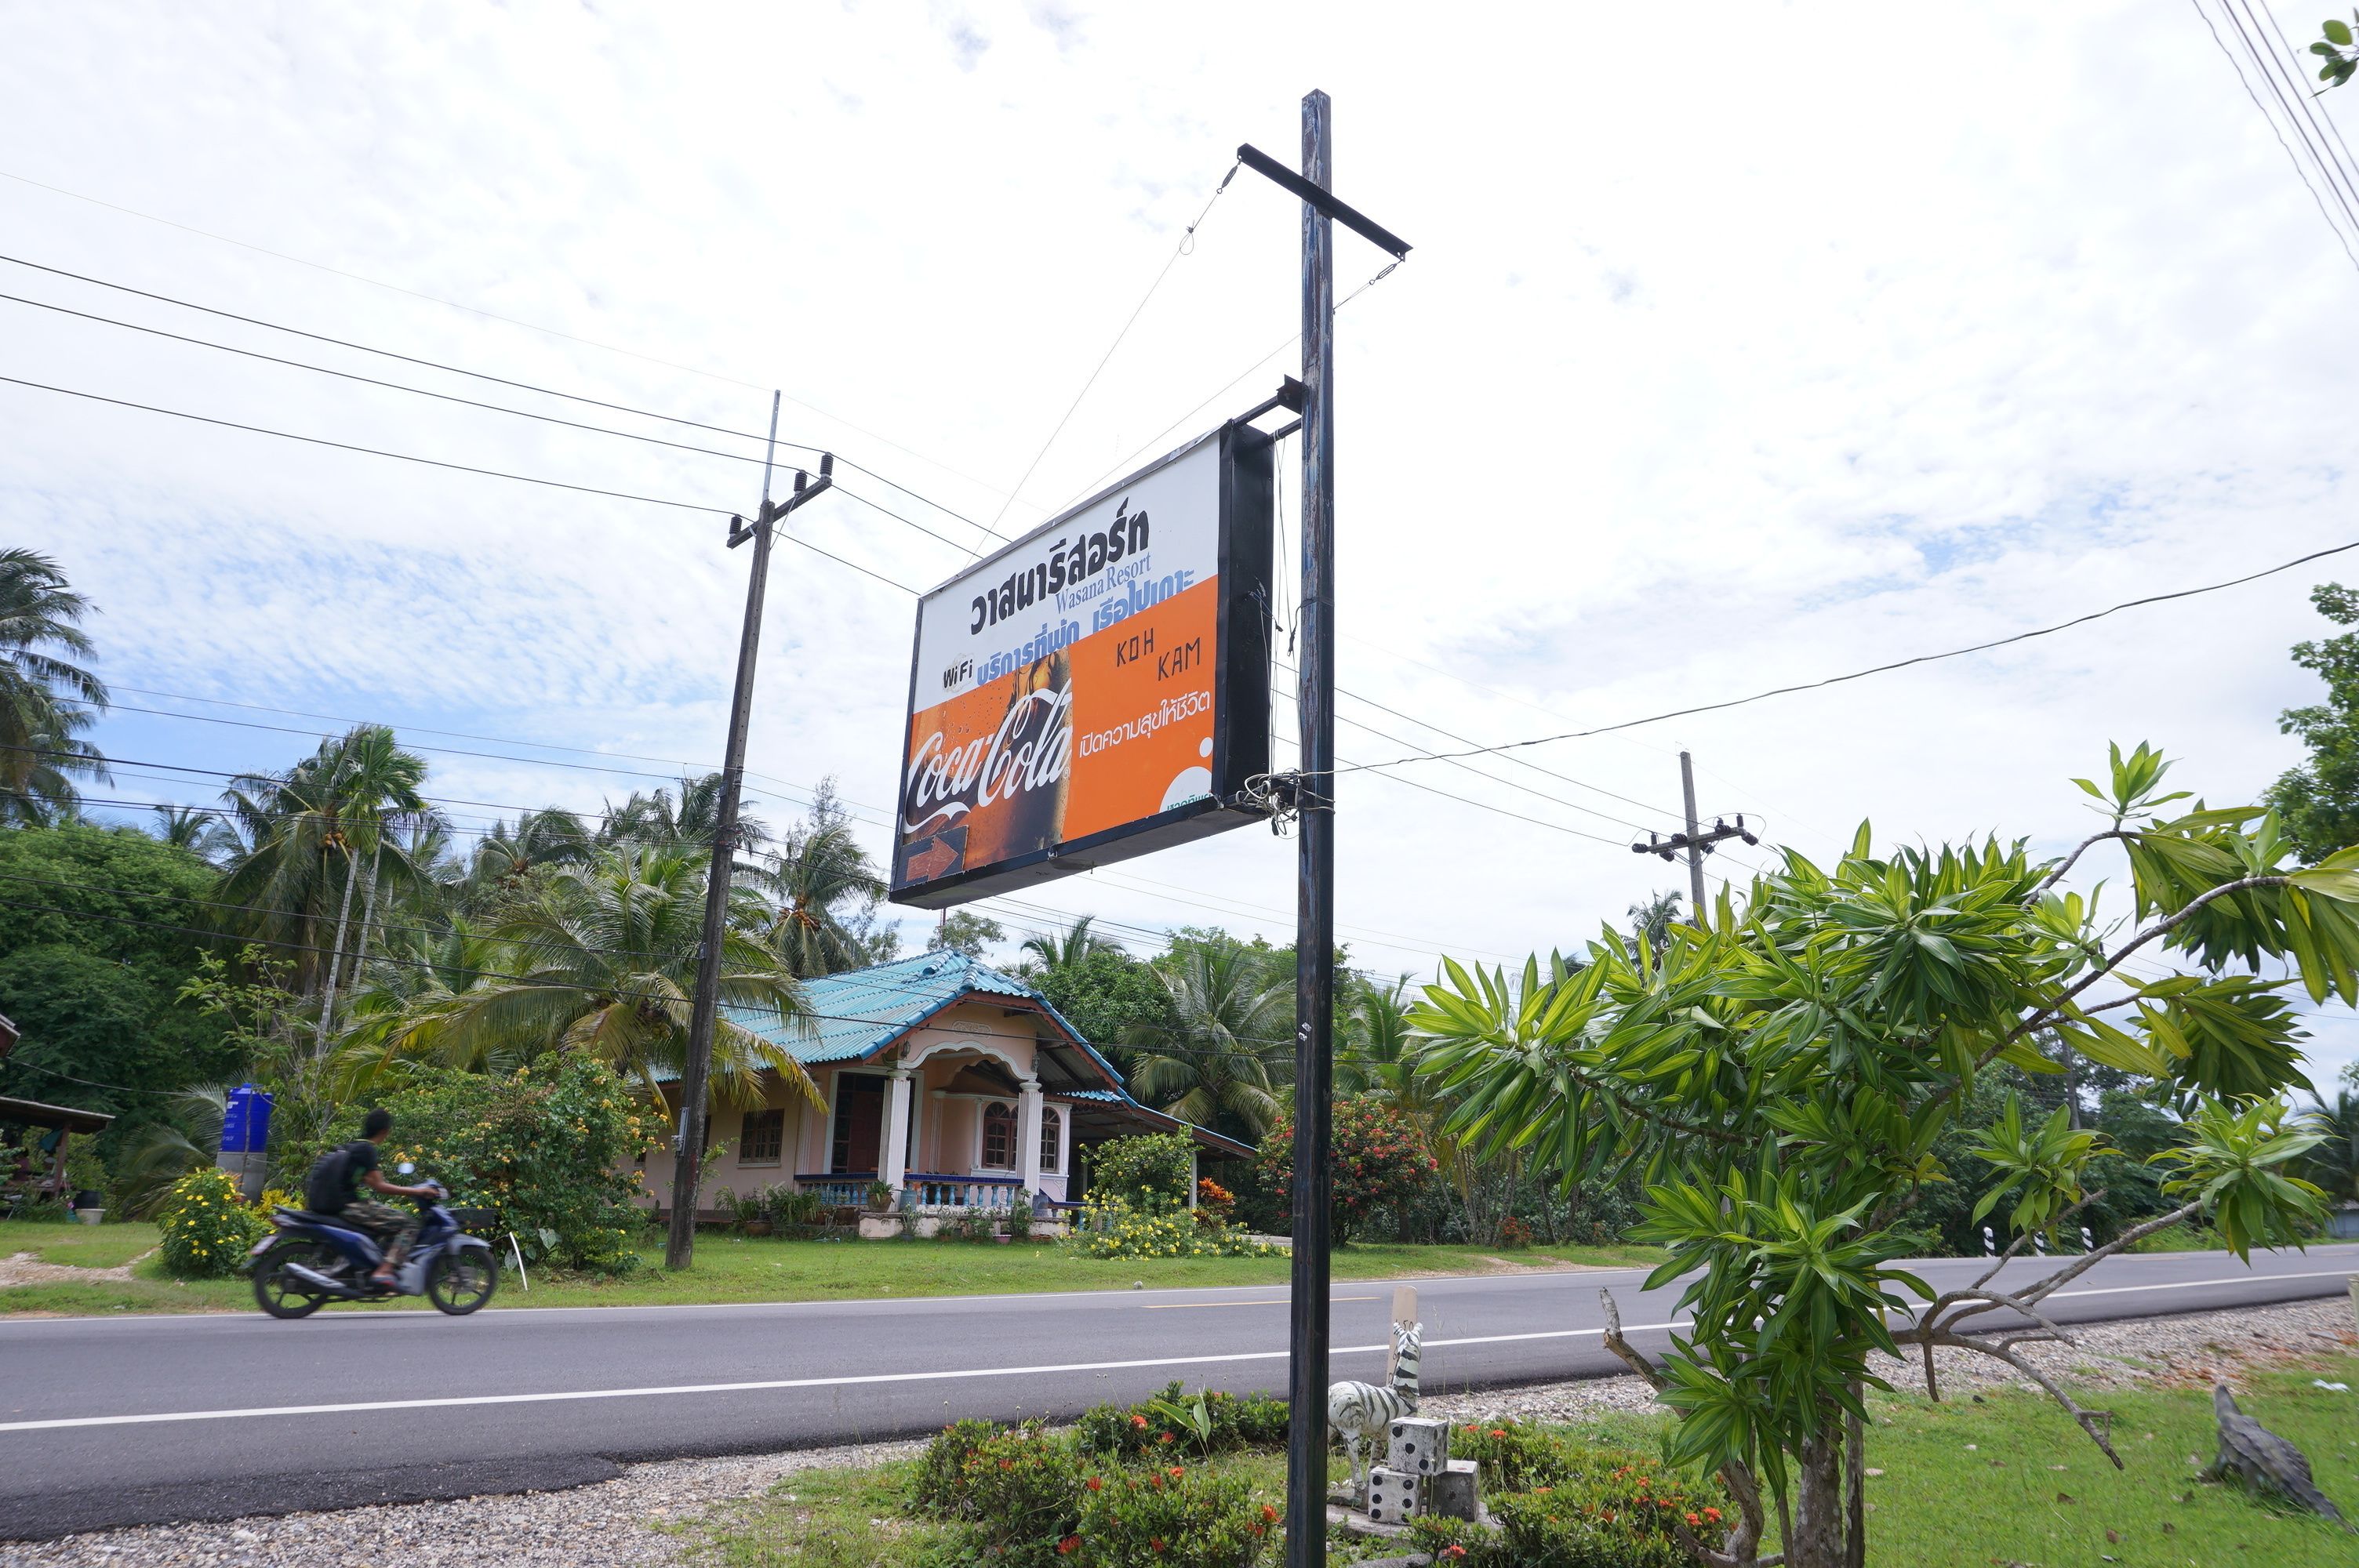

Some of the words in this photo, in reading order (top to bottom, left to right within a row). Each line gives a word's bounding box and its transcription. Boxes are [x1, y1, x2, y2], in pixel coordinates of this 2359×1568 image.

[971, 496, 1150, 635] วาสนารีสอร์ท
[1056, 577, 1104, 615] Wasana
[1105, 551, 1151, 591] Resort
[1092, 569, 1194, 633] เรือไปเกาะ
[943, 659, 973, 688] WiFi
[1117, 627, 1154, 667] KOH
[1158, 637, 1201, 681] KAM
[1079, 690, 1211, 758] เปิดความสุขให้ชีวิต
